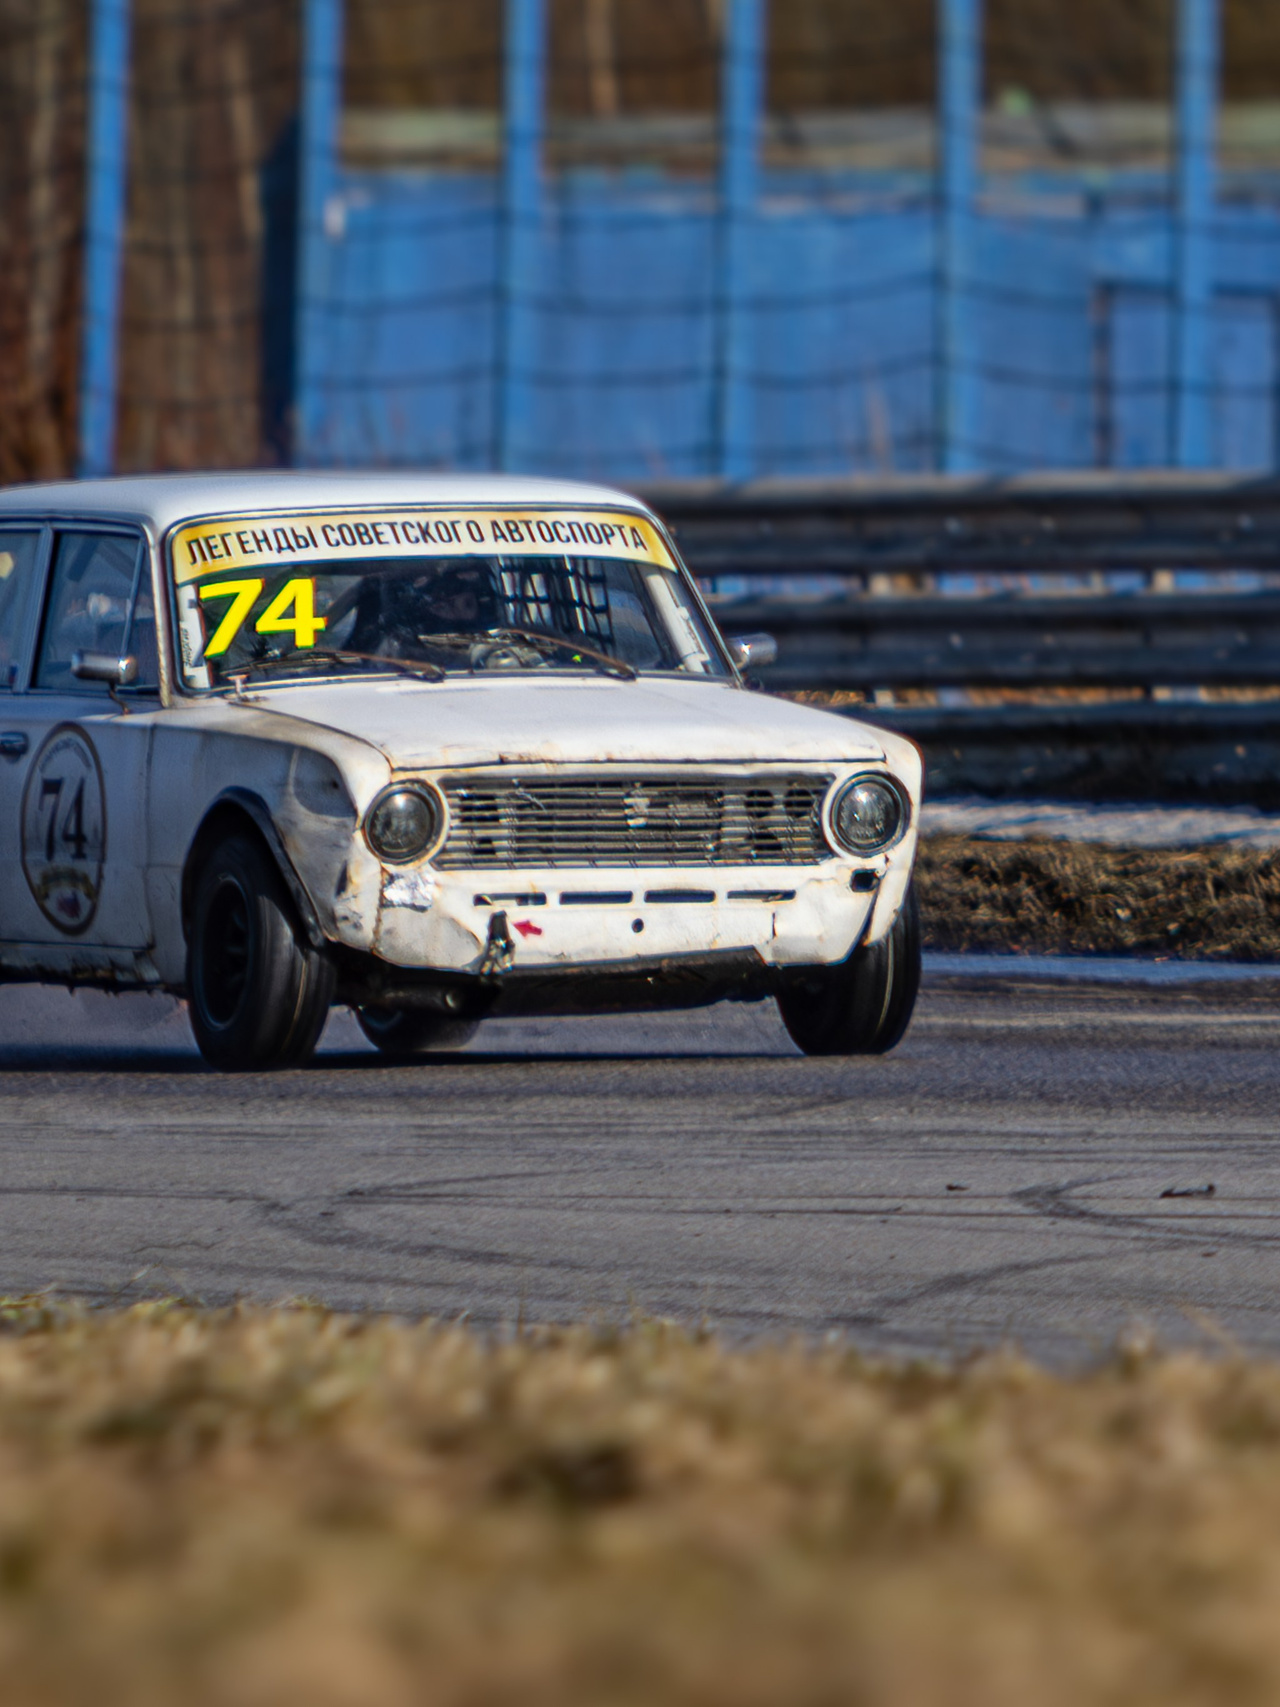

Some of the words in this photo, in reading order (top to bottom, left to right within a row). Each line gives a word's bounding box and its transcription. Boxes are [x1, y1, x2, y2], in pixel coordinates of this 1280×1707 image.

[186, 525, 318, 566] ЛЕГЕНДЫ
[322, 521, 484, 550] СОВЕТСКОГО
[490, 519, 648, 551] АВТОСПОРТА
[199, 577, 325, 659] 74
[38, 777, 87, 862] 74
